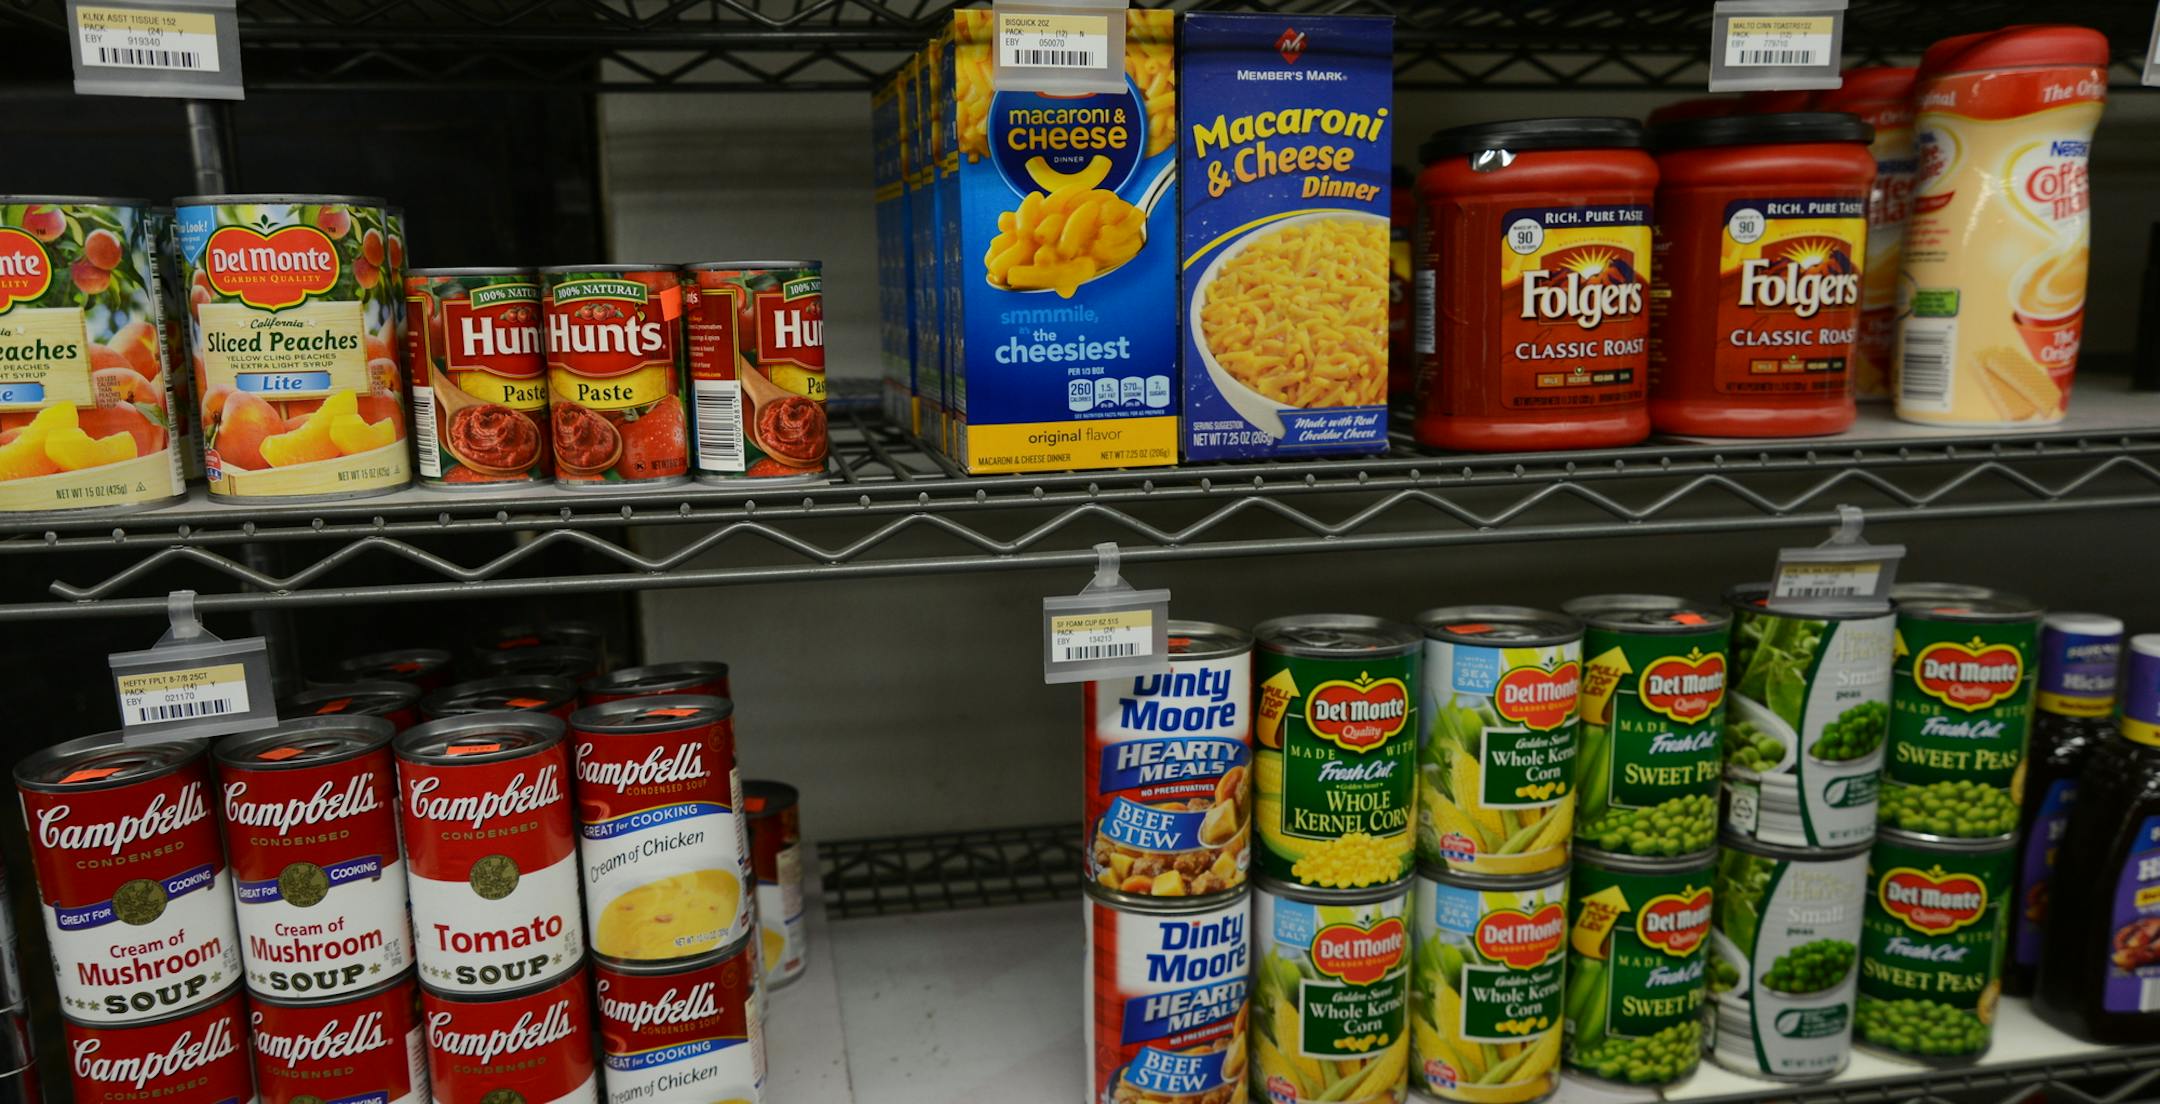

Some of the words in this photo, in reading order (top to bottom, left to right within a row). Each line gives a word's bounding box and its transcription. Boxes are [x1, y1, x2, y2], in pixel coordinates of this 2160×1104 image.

[83, 13, 104, 22] KLNX
[107, 15, 127, 23] ASST
[131, 16, 159, 25] TISSUE
[162, 18, 176, 26] 152
[1005, 19, 1036, 27] BISQUICK
[85, 34, 102, 43] EBY
[128, 36, 160, 46] 919340
[148, 27, 164, 36] (24)
[1005, 38, 1019, 46] EBY
[1039, 39, 1065, 47] 050070
[1237, 70, 1303, 81] MEMBER'S
[1009, 108, 1109, 125] macaroni
[1193, 107, 1389, 159] Macaroni
[1207, 160, 1232, 198] &
[1233, 141, 1355, 183] Cheese
[1302, 175, 1381, 202] Dinner
[1545, 213, 1581, 224] RICH.
[1585, 211, 1615, 222] PURE
[1619, 210, 1643, 221] TASTE
[1767, 203, 1805, 215] RICH.
[1808, 203, 1837, 214] PURE
[1839, 203, 1863, 213] TASTE
[1739, 221, 1754, 233] 90
[1517, 231, 1533, 244] 90
[213, 249, 247, 272] Del
[250, 248, 331, 271] Monte
[224, 275, 266, 284] GARDEN
[271, 274, 321, 283] QUALITY
[790, 282, 810, 294] 100%
[1738, 258, 1858, 318] Folgers
[478, 289, 505, 302] 100%
[558, 284, 580, 298] 100%
[583, 284, 640, 297] NATURAL
[1520, 269, 1642, 329] Folgers
[250, 317, 303, 329] California
[208, 332, 261, 352] Sliced
[270, 330, 358, 350] Peaches
[550, 314, 663, 357] Hunt's
[1033, 328, 1057, 342] the
[1730, 330, 1813, 346] CLASSIC
[995, 335, 1130, 364] cheesiest
[1515, 340, 1598, 360] CLASSIC
[1603, 338, 1644, 356] ROAST
[3, 363, 50, 372] PEACHES
[272, 361, 299, 369] LIGHT
[263, 376, 302, 390] Lite
[577, 383, 633, 401] Paste
[1070, 383, 1091, 396] 260
[503, 385, 546, 402] Paste
[1295, 417, 1326, 428] Made
[1328, 416, 1351, 428] with
[1353, 414, 1378, 426] Real
[1029, 429, 1081, 446] original
[1086, 428, 1122, 441] flavor
[1193, 433, 1209, 446] NET
[1210, 433, 1221, 446] WT
[1223, 433, 1238, 445] 7.25
[1299, 429, 1341, 442] Cheddar
[1343, 428, 1376, 440] Cheese
[978, 456, 1013, 466] MACARONI
[1021, 455, 1046, 464] CHEESE
[1047, 454, 1071, 463] DINNER
[124, 679, 146, 688] HEFTY
[149, 677, 166, 685] FPLT
[170, 675, 188, 683] 8-7/8
[190, 673, 207, 681] 25CT
[1461, 668, 1489, 679] SEA
[1924, 660, 1957, 680] Del
[1960, 663, 2018, 683] Monte
[183, 683, 197, 692] (14)
[1265, 685, 1289, 700] PULL
[1457, 678, 1492, 689] SALT
[1649, 676, 1680, 695] Del
[1949, 685, 1993, 699] Quality
[126, 697, 142, 706] EBY
[165, 692, 194, 701] 021170
[1505, 684, 1534, 704] Del
[1836, 689, 1861, 700] peas
[1119, 698, 1236, 732] Moore
[1315, 700, 1348, 721] Del
[1350, 698, 1404, 721] Monte
[1512, 704, 1547, 713] GARDEN
[1342, 725, 1381, 739] Quality
[1621, 719, 1668, 733] MADE
[1116, 741, 1240, 771] HEARTY
[1291, 745, 1336, 760] MADE
[1492, 750, 1544, 767] Whole
[1896, 741, 1970, 770] SWEET
[1974, 748, 2018, 771] PEAS
[575, 741, 706, 794] Campbell's
[1139, 762, 1225, 784] MEALS
[1526, 766, 1561, 782] Corn
[1625, 763, 1693, 785] SWEET
[410, 764, 561, 830] Campbell's
[626, 783, 683, 797] CONDENSED
[1154, 784, 1215, 795] PRESERVATIVES
[224, 772, 378, 836] Campbell's
[1326, 790, 1391, 813] WHOLE
[37, 781, 207, 856] Campbell's
[630, 804, 698, 829] COOKING
[1116, 800, 1175, 831] BEEF
[1294, 808, 1366, 833] KERNEL
[250, 830, 350, 847] CONDENSED
[441, 821, 538, 841] CONDENSED
[1109, 820, 1182, 850] STEW
[642, 830, 704, 857] Chicken
[76, 840, 185, 870] CONDENSED
[331, 861, 377, 880] COOKING
[60, 913, 90, 926] GREAT
[92, 908, 111, 920] FOR
[168, 869, 211, 894] COOKING
[1887, 882, 1919, 904] Del
[1921, 888, 1982, 910] Monte
[275, 920, 323, 938] Cream
[327, 916, 345, 932] of
[1159, 913, 1244, 950] Dinty
[1647, 913, 1676, 932] Del
[110, 938, 163, 959] Cream
[168, 928, 185, 946] of
[434, 914, 563, 955] Tomato
[1484, 924, 1514, 944] Del
[250, 928, 383, 964] Mushroom
[1320, 939, 1351, 959] Del
[77, 936, 221, 987] Mushroom
[456, 954, 550, 985] SOUP
[1146, 943, 1246, 982] Moore
[269, 963, 365, 993] SOUP
[1863, 957, 1931, 991] SWEET
[104, 973, 207, 1014] SOUP
[1144, 982, 1247, 1022] HEARTY
[1472, 986, 1525, 1004] Whole
[1309, 1002, 1363, 1019] Whole
[1505, 1002, 1543, 1018] Corn
[1623, 994, 1684, 1017] SWEET
[1168, 1001, 1240, 1033] MEALS
[1343, 1019, 1382, 1034] Corn
[428, 1000, 572, 1066] Campbell's
[73, 1016, 234, 1090] Campbell's
[646, 1040, 712, 1064] COOKING
